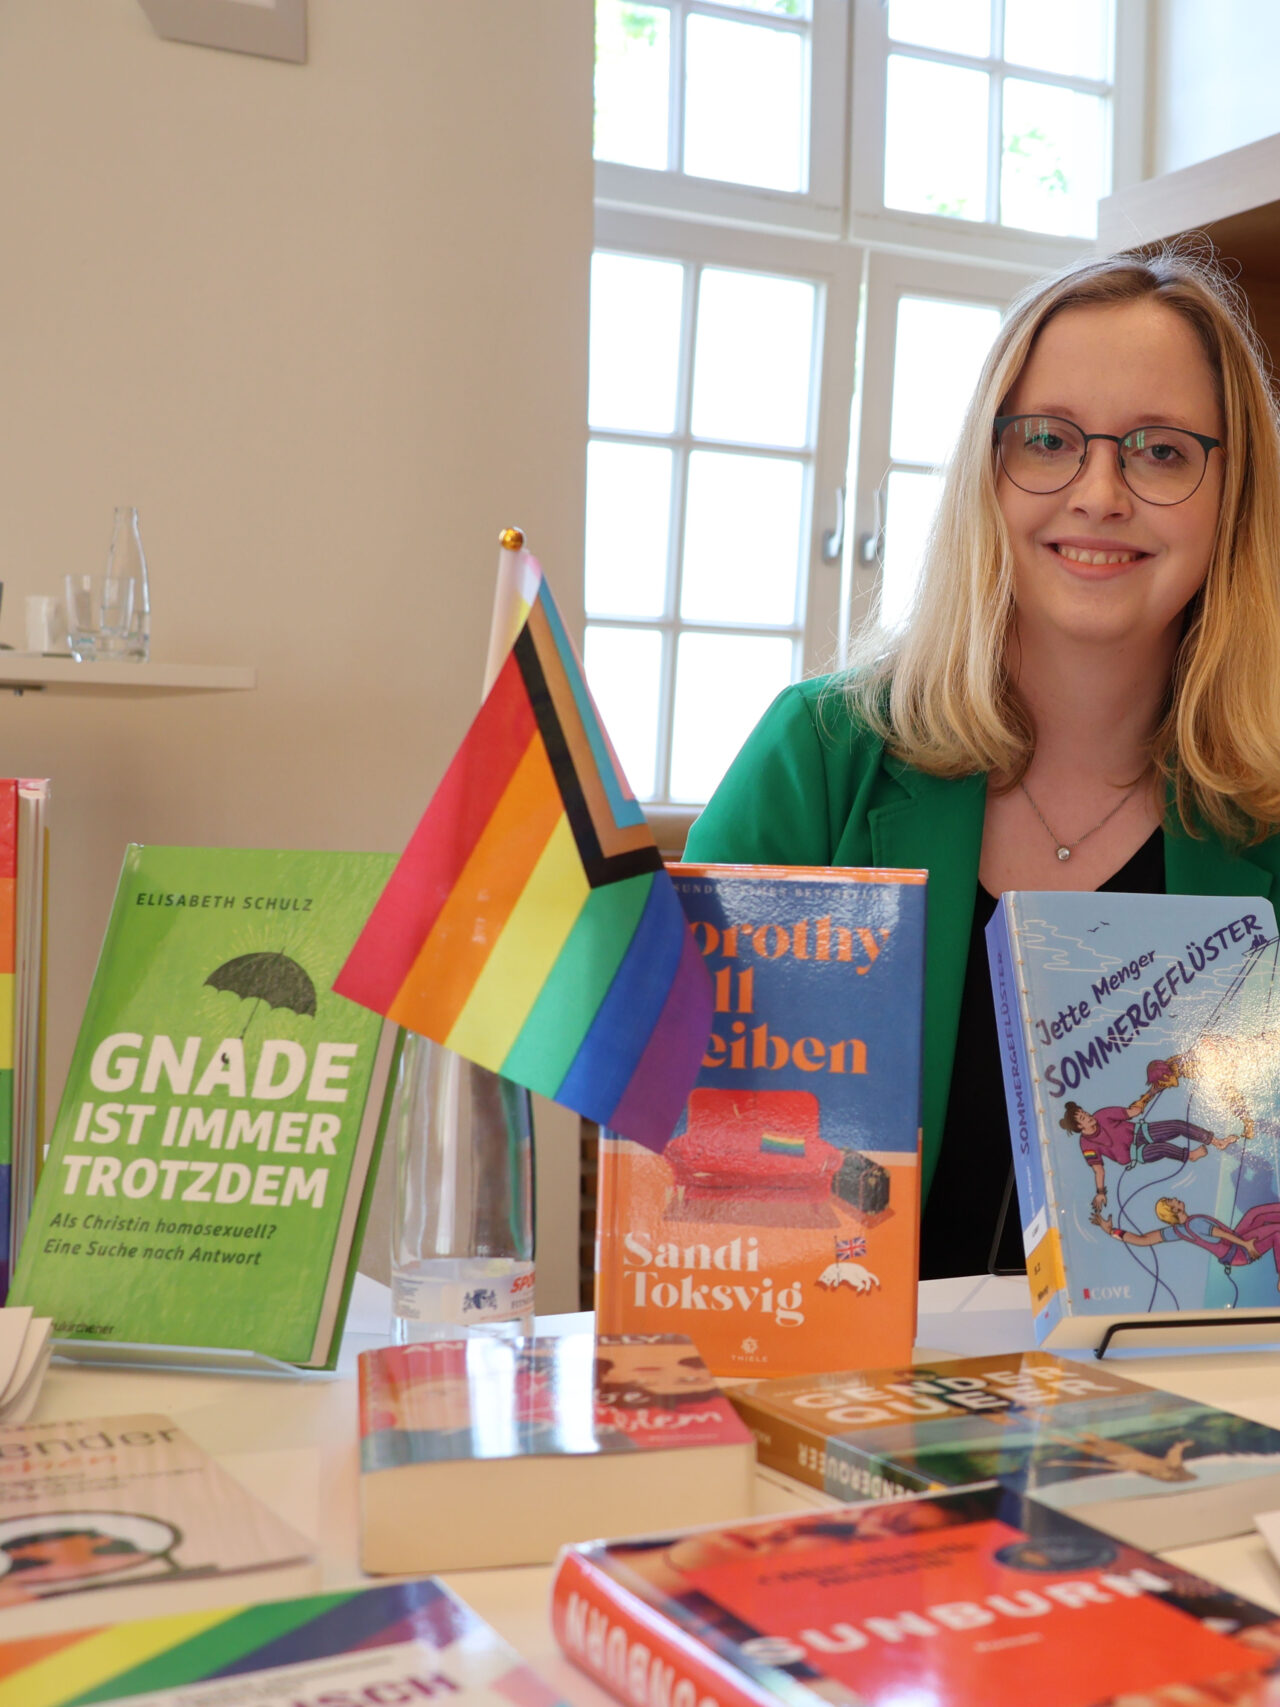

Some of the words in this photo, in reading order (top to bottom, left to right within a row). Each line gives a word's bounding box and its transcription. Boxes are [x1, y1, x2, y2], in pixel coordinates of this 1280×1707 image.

[136, 892, 235, 909] ELISABETH
[242, 896, 314, 912] SCHULZ
[689, 913, 891, 976] orothy
[714, 965, 754, 1014] ll
[1035, 1000, 1092, 1046] Jette
[1091, 950, 1156, 1004] Menger
[1044, 913, 1264, 1098] SOMMERGEFLÜSTER
[89, 1032, 359, 1102] GNADE
[701, 1020, 869, 1074] eiben
[73, 1101, 157, 1145] IST
[161, 1105, 342, 1156] IMMER
[62, 1154, 330, 1209] TROTZDEM
[43, 1238, 82, 1256] Eine
[86, 1240, 138, 1259] Suche
[142, 1246, 186, 1261] nach
[188, 1246, 262, 1266] Antwort
[49, 1212, 79, 1229] Als
[82, 1214, 152, 1233] Christin
[154, 1218, 278, 1240] homosexuell?
[623, 1231, 759, 1272] Sandi
[623, 1270, 805, 1328] Toksvig
[730, 1354, 768, 1362] THIELE
[791, 1366, 1080, 1410] GENDER
[826, 1379, 1119, 1424] QUEER
[0, 1430, 179, 1457] ender
[797, 1441, 917, 1499] ENDERQUEER
[741, 1568, 1173, 1666] SUNBURN
[565, 1590, 720, 1707] UNBURN
